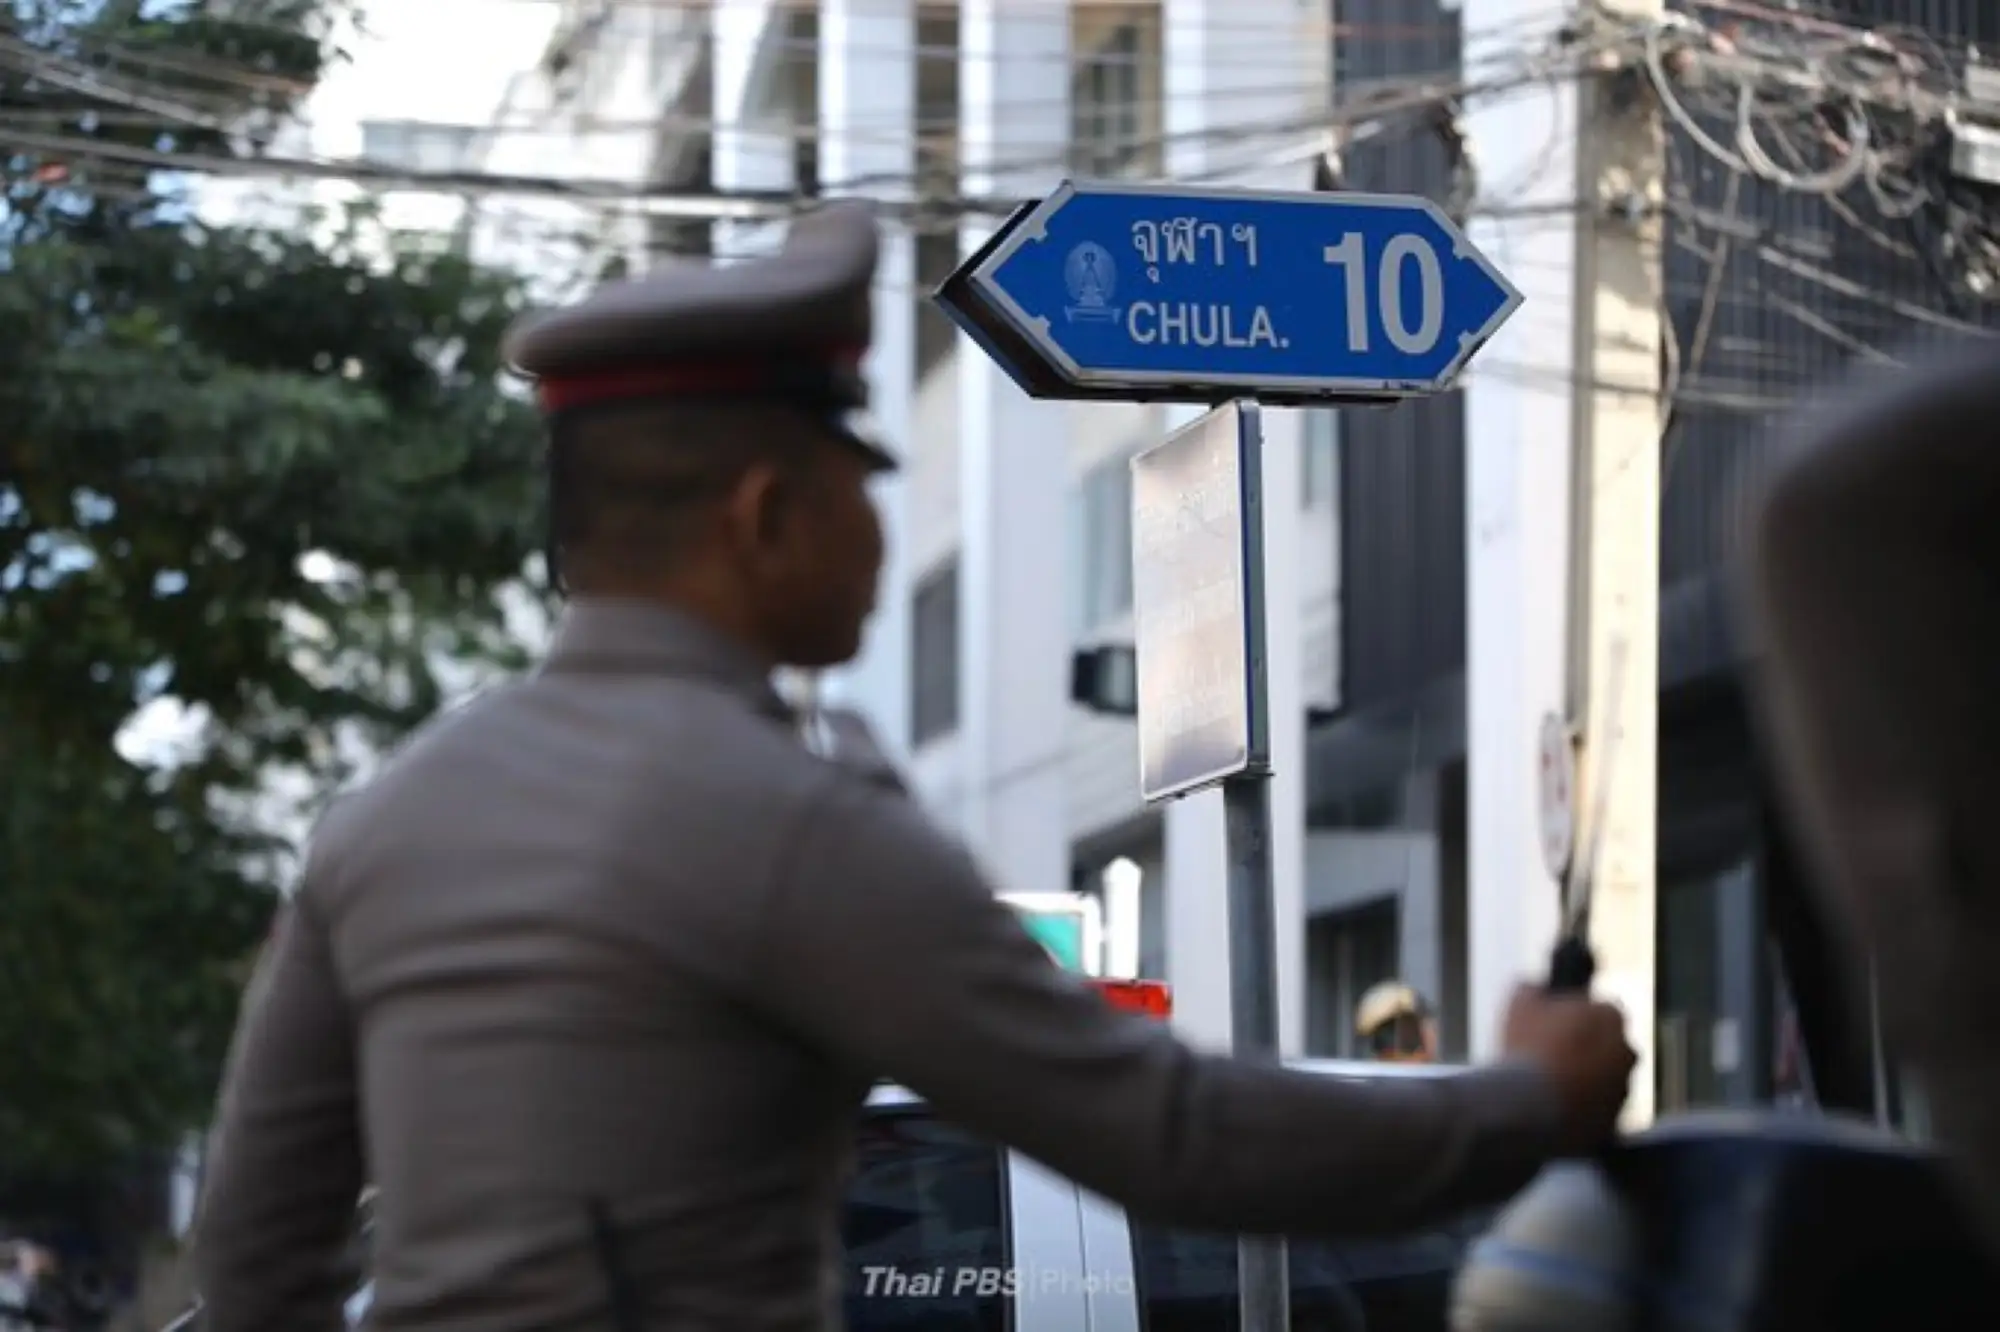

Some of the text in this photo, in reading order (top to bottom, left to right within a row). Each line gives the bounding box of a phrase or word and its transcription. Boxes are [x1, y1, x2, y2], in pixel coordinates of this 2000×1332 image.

[1131, 217, 1257, 283] จุฬาฯ
[1128, 301, 1290, 348] CHULA.
[1323, 231, 1445, 355] 10
